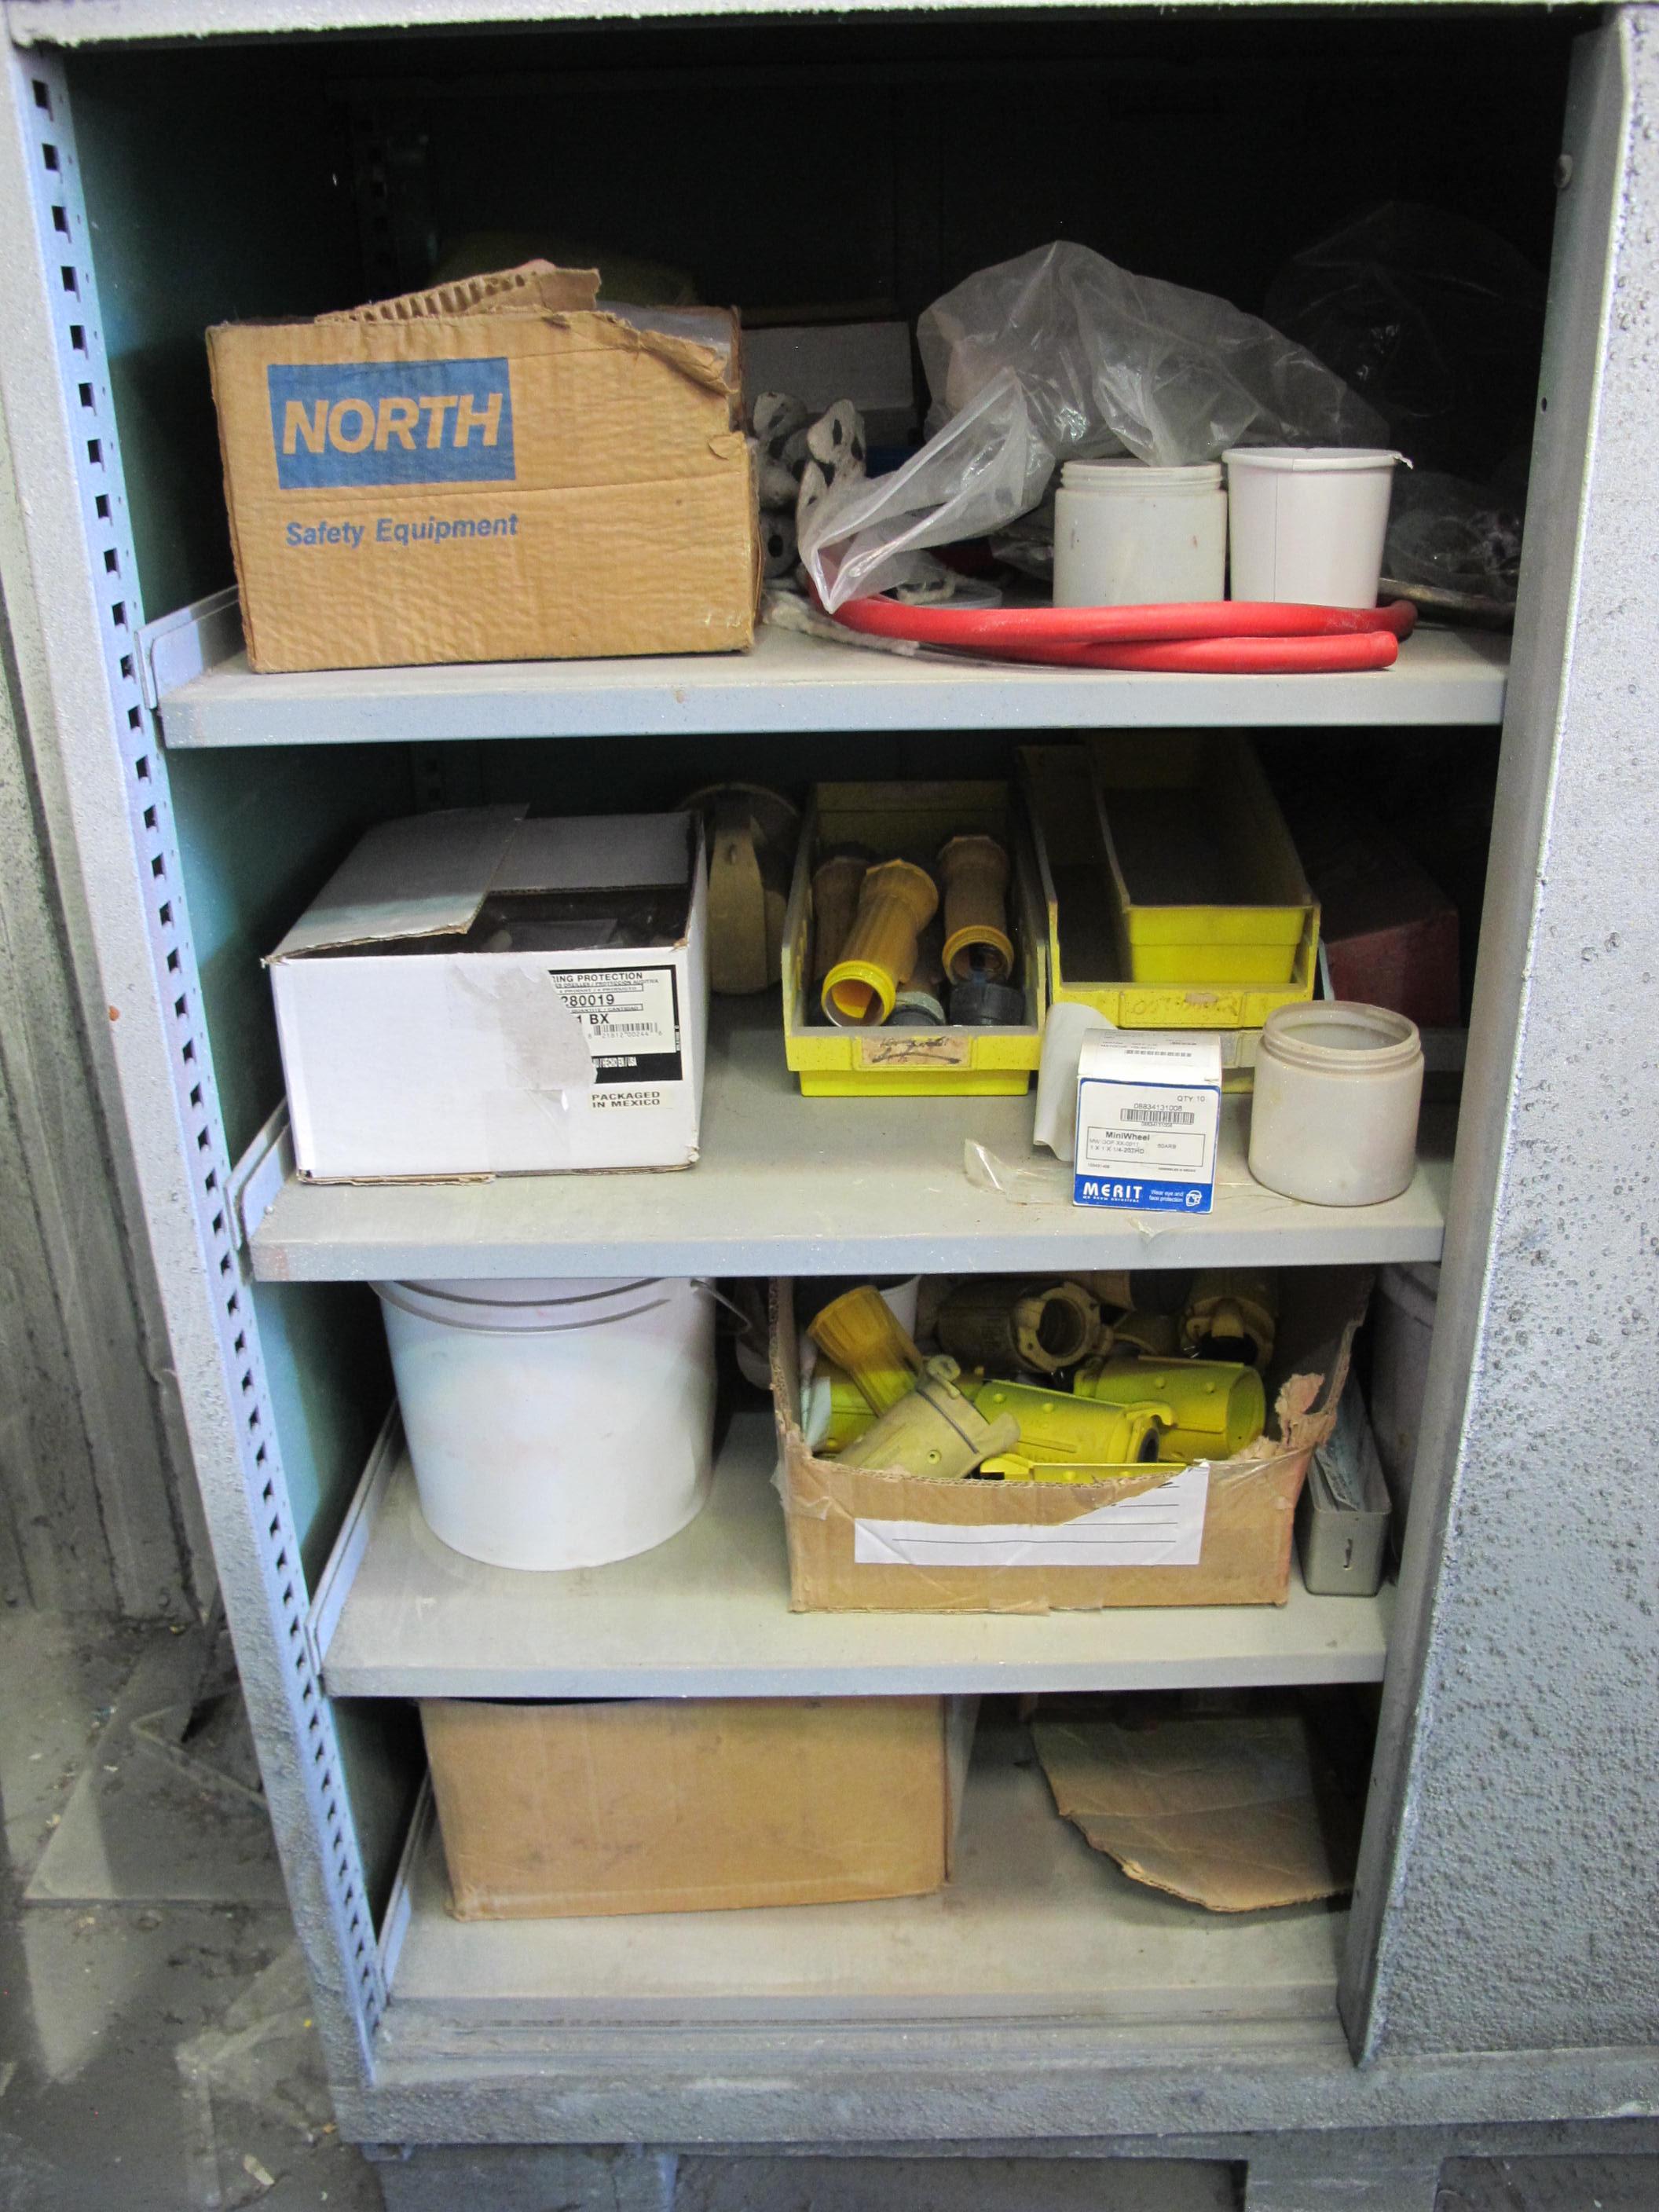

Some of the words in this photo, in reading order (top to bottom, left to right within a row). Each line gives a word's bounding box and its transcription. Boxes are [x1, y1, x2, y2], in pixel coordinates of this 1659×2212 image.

[283, 393, 503, 455] NORTH
[286, 522, 364, 548] Safety
[376, 514, 518, 546] Equipment
[577, 972, 643, 982] PROTECTION
[590, 1013, 610, 1024] BX
[591, 1091, 661, 1101] PACKAGED
[611, 1099, 661, 1108] MEXICO
[1133, 1103, 1182, 1111] 08834131008
[1105, 1131, 1150, 1141] MiniWheel
[1083, 1181, 1142, 1199] MERIT
